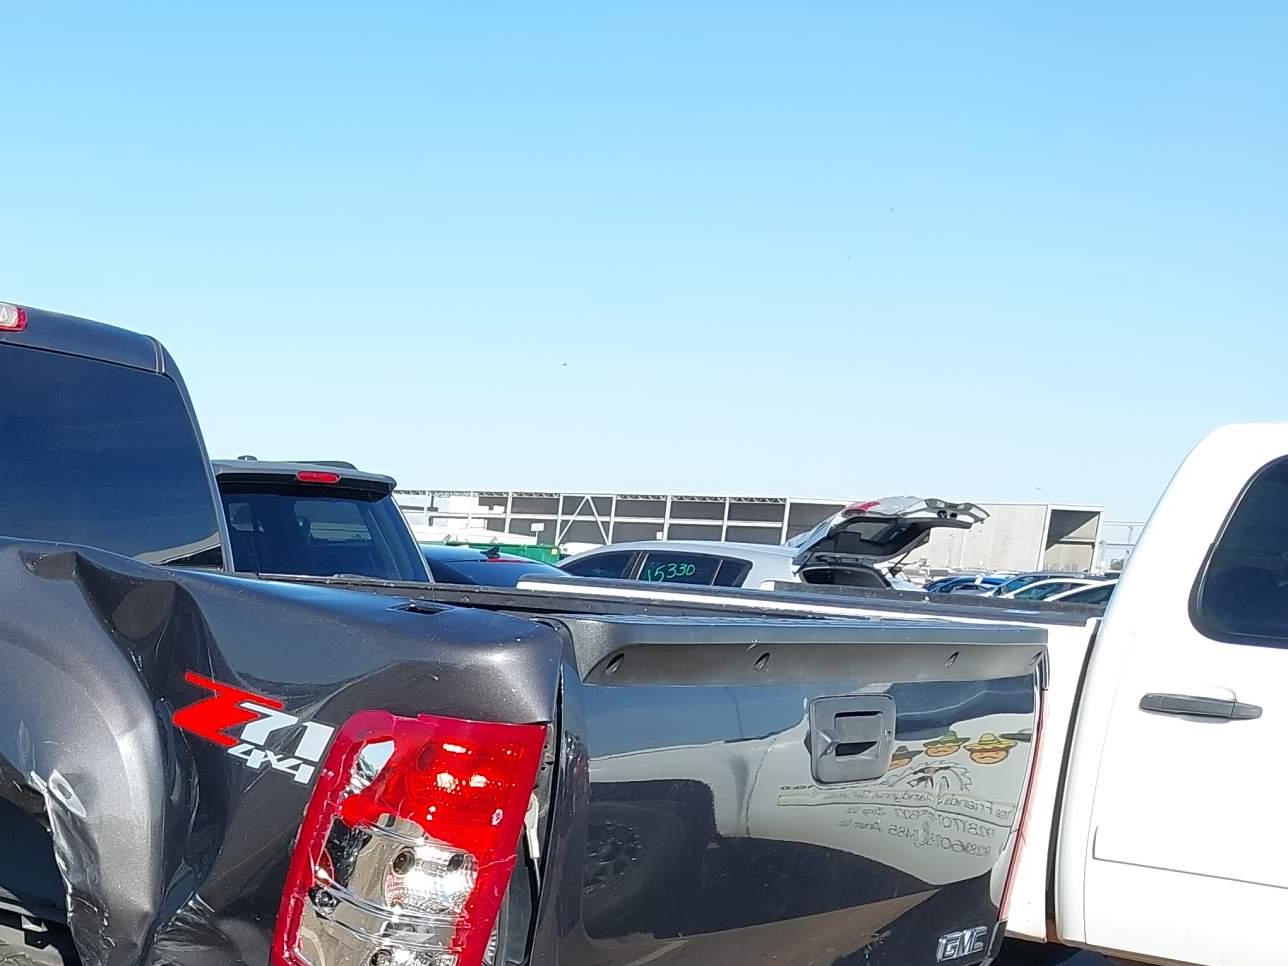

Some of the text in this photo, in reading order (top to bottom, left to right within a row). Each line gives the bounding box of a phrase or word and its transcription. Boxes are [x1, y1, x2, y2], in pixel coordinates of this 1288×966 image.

[648, 563, 696, 584] 15330
[172, 671, 335, 763] Z71
[937, 926, 988, 962] GMC
